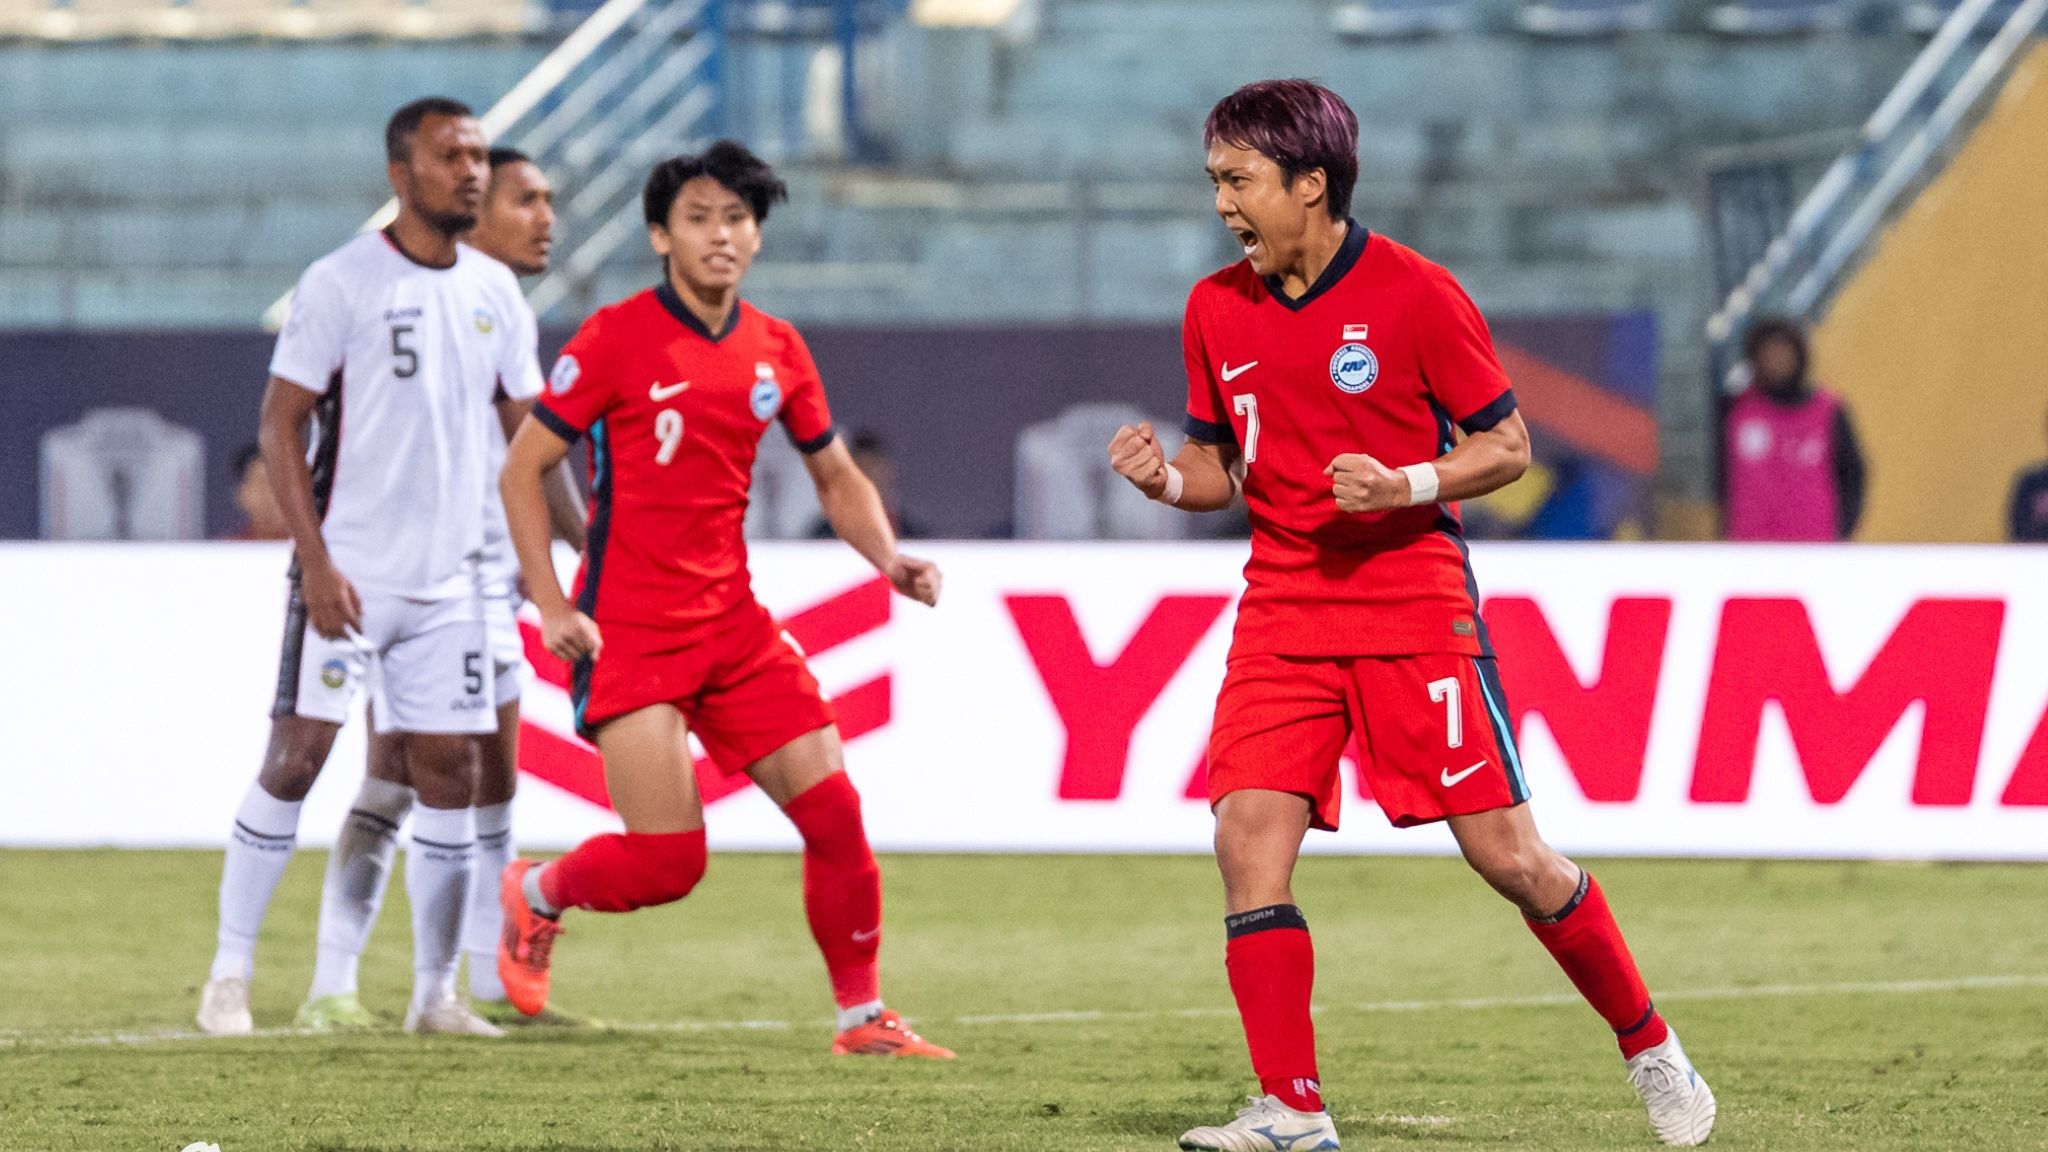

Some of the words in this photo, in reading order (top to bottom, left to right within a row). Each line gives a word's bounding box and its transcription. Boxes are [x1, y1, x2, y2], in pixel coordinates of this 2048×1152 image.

[391, 324, 418, 378] 5
[1336, 378, 1371, 391] SINGAPORE
[654, 408, 684, 465] 9
[1232, 393, 1260, 463] 7
[464, 651, 483, 695] 5
[1004, 594, 2048, 805] YNM
[1427, 676, 1463, 749] 7
[1229, 908, 1276, 928] G-FORM
